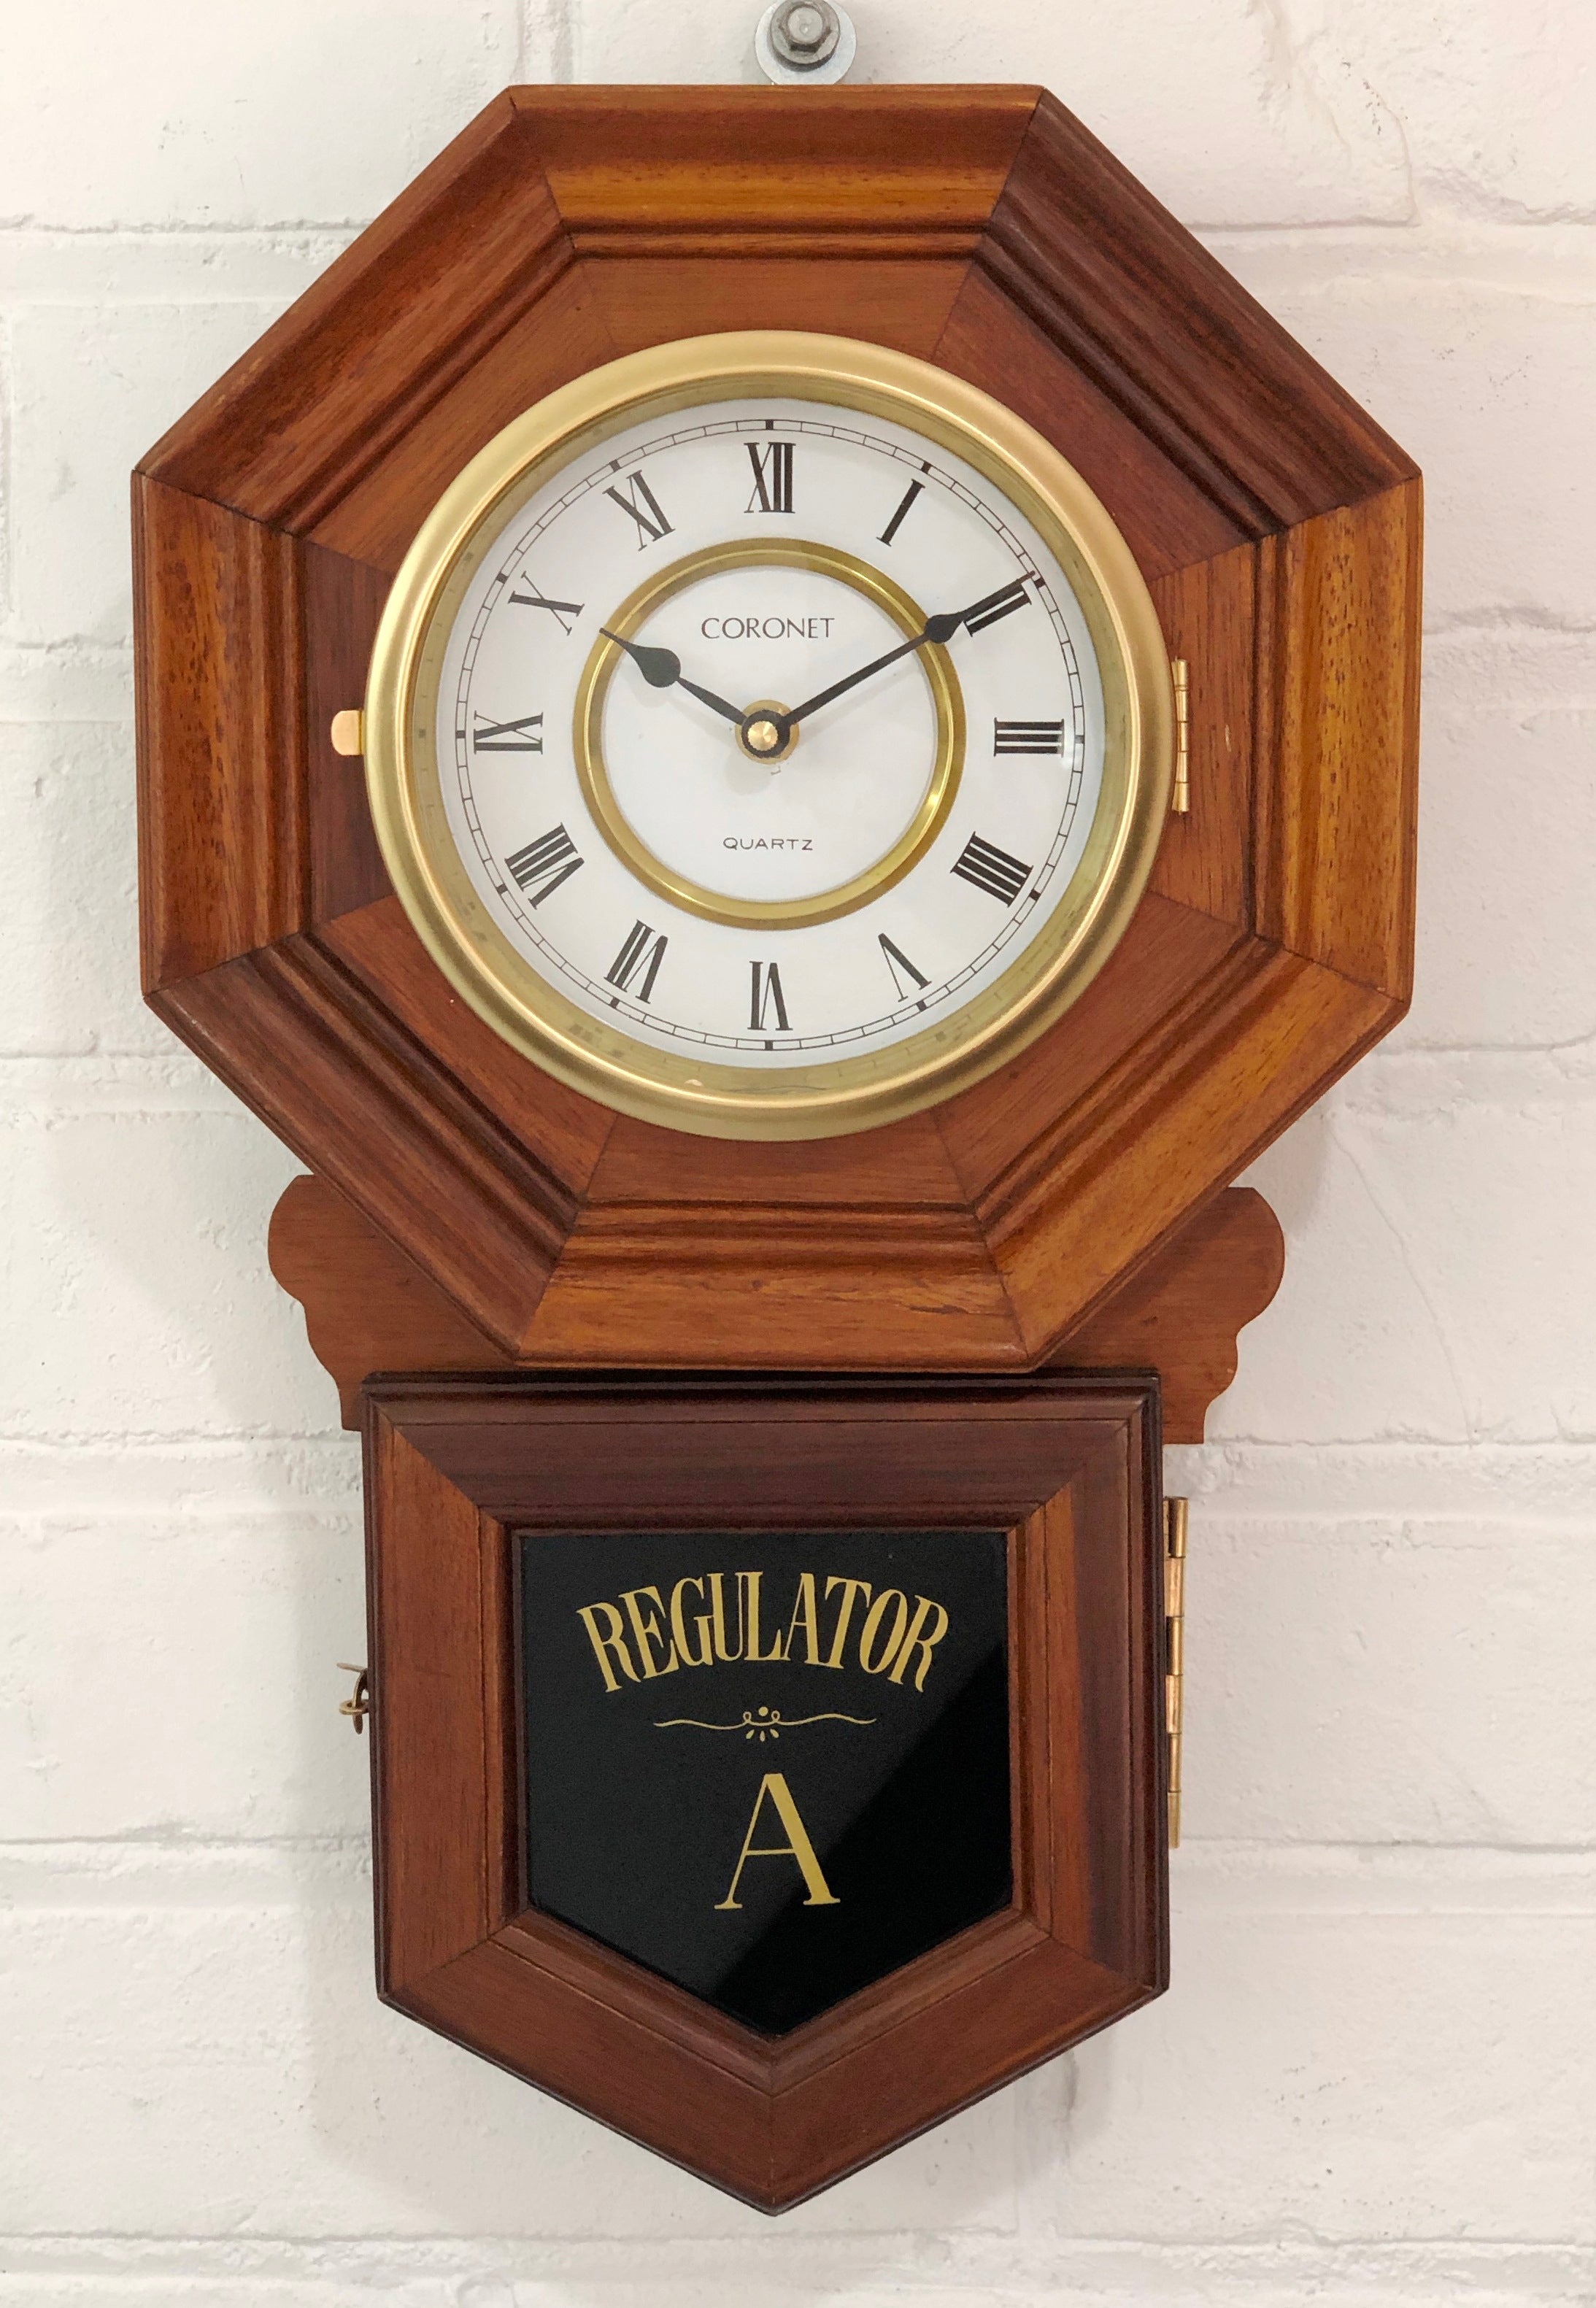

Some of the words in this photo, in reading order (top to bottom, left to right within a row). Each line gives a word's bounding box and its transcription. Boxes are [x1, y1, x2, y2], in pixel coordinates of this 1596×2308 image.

[602, 470, 676, 551] XI
[744, 442, 796, 513] XII
[876, 479, 925, 547] I
[508, 571, 585, 635] X
[701, 617, 835, 639] CORONET
[474, 711, 543, 754] IX
[994, 717, 1064, 757] III
[505, 822, 585, 910] VIII
[723, 838, 813, 851] QUARTZ
[950, 831, 1033, 907] IIII
[604, 919, 668, 1003] VII
[747, 960, 793, 1030] VI
[878, 933, 932, 1003] V
[576, 1571, 948, 1693] REGULATOR
[714, 1773, 841, 1910] A
